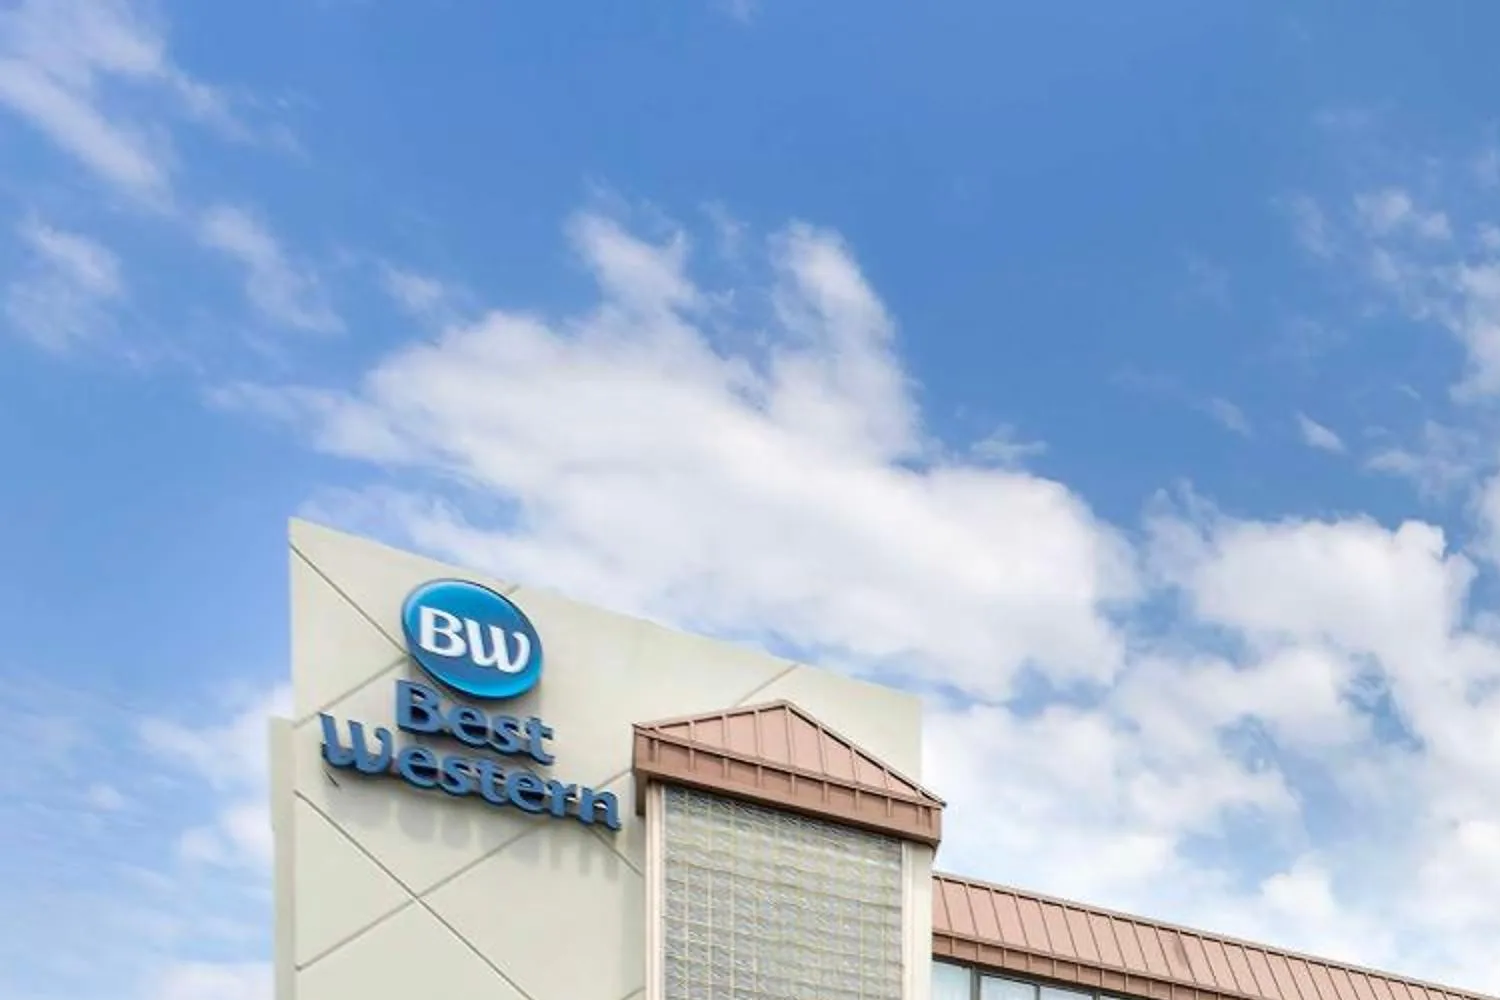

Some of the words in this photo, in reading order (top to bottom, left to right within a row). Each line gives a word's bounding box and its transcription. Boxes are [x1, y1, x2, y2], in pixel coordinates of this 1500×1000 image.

[419, 605, 531, 674] BW
[395, 679, 555, 766] Best
[318, 711, 623, 831] Western
